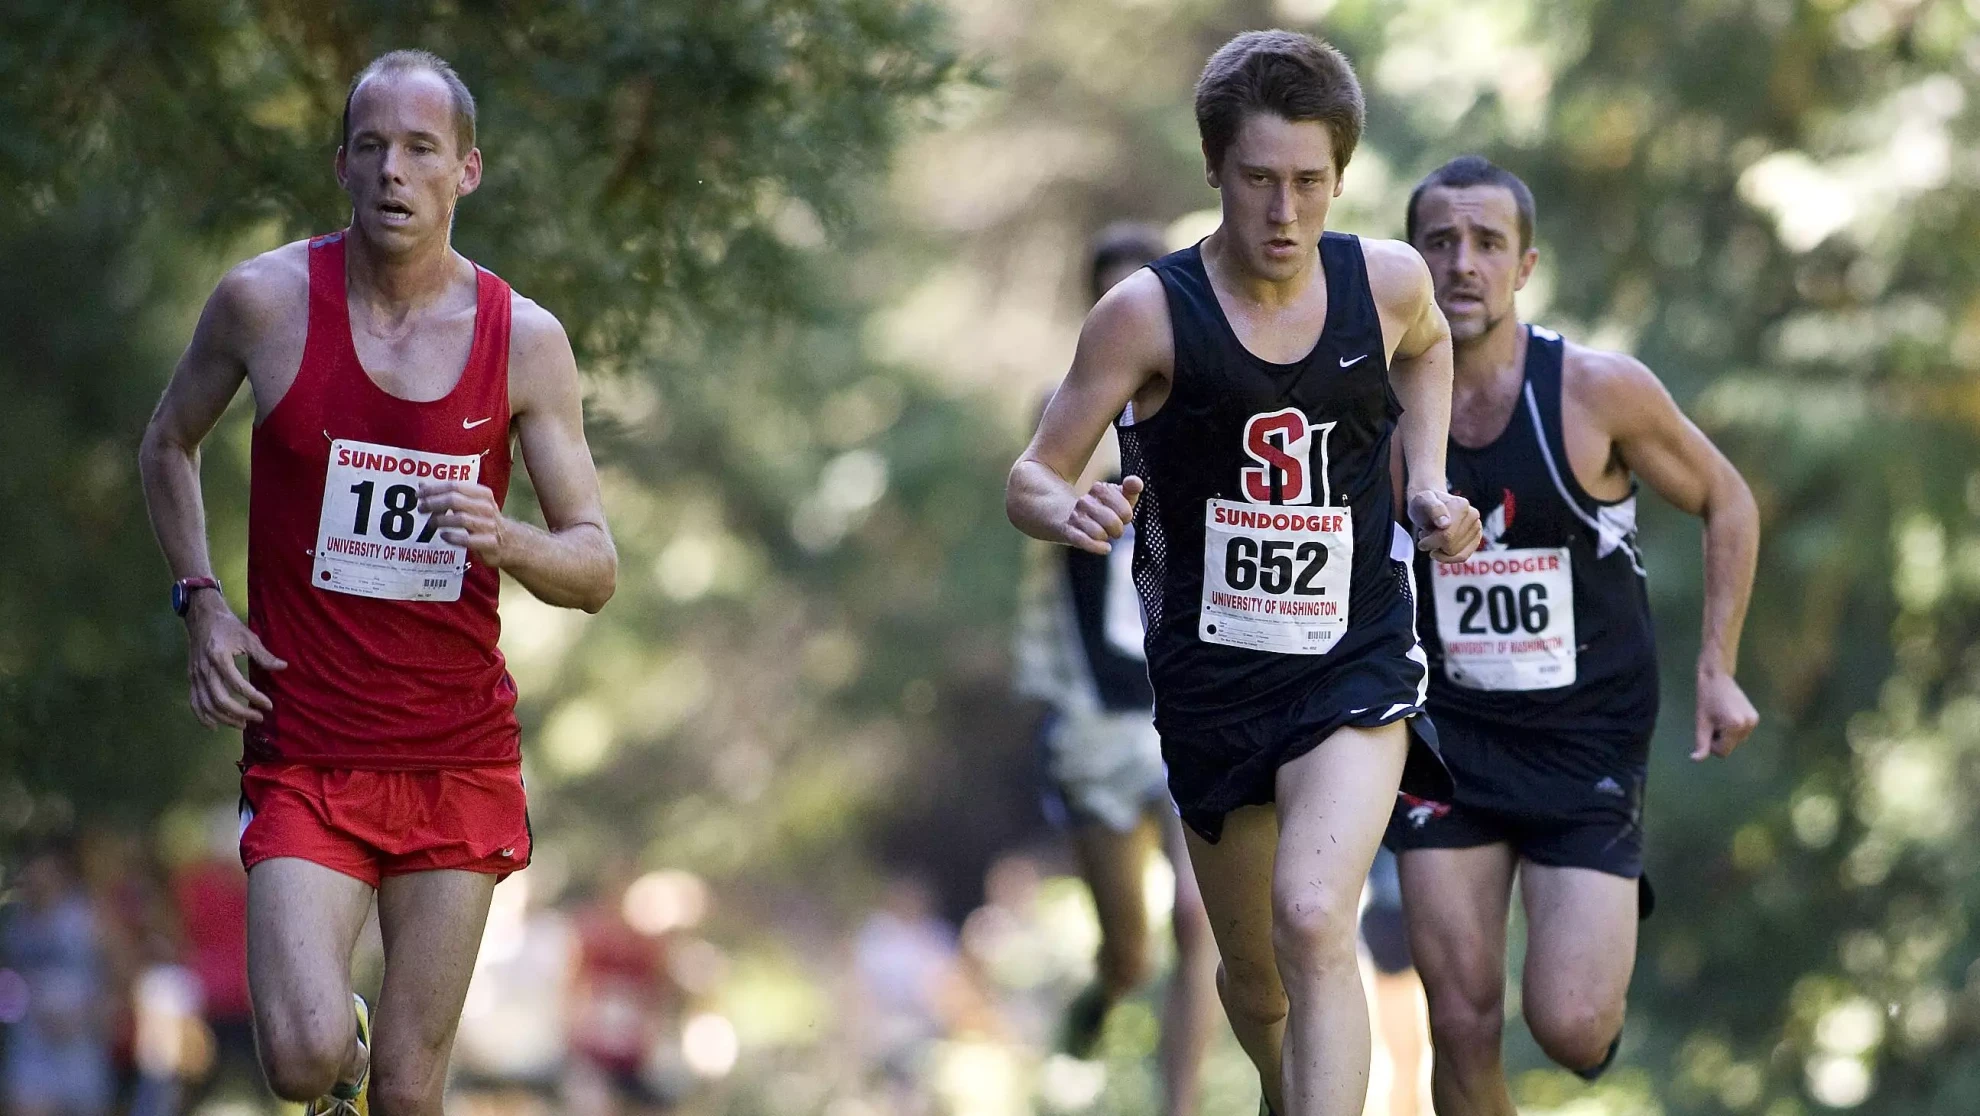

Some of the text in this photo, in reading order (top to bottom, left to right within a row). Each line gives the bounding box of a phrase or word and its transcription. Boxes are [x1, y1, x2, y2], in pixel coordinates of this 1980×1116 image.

[337, 449, 471, 481] SUNDODGER
[1215, 507, 1343, 533] SUNDODGER
[327, 536, 382, 559] UNIVERSITY
[383, 545, 396, 561] OF
[398, 546, 456, 565] WASHINGTON
[1225, 536, 1328, 596] 652
[1438, 555, 1560, 576] SUNDODGER
[1212, 590, 1337, 616] UNIVERSITY OF WASHINGTON
[1456, 583, 1549, 635] 206
[1450, 636, 1563, 656] UNIVERSITY OF WASHINGTON
